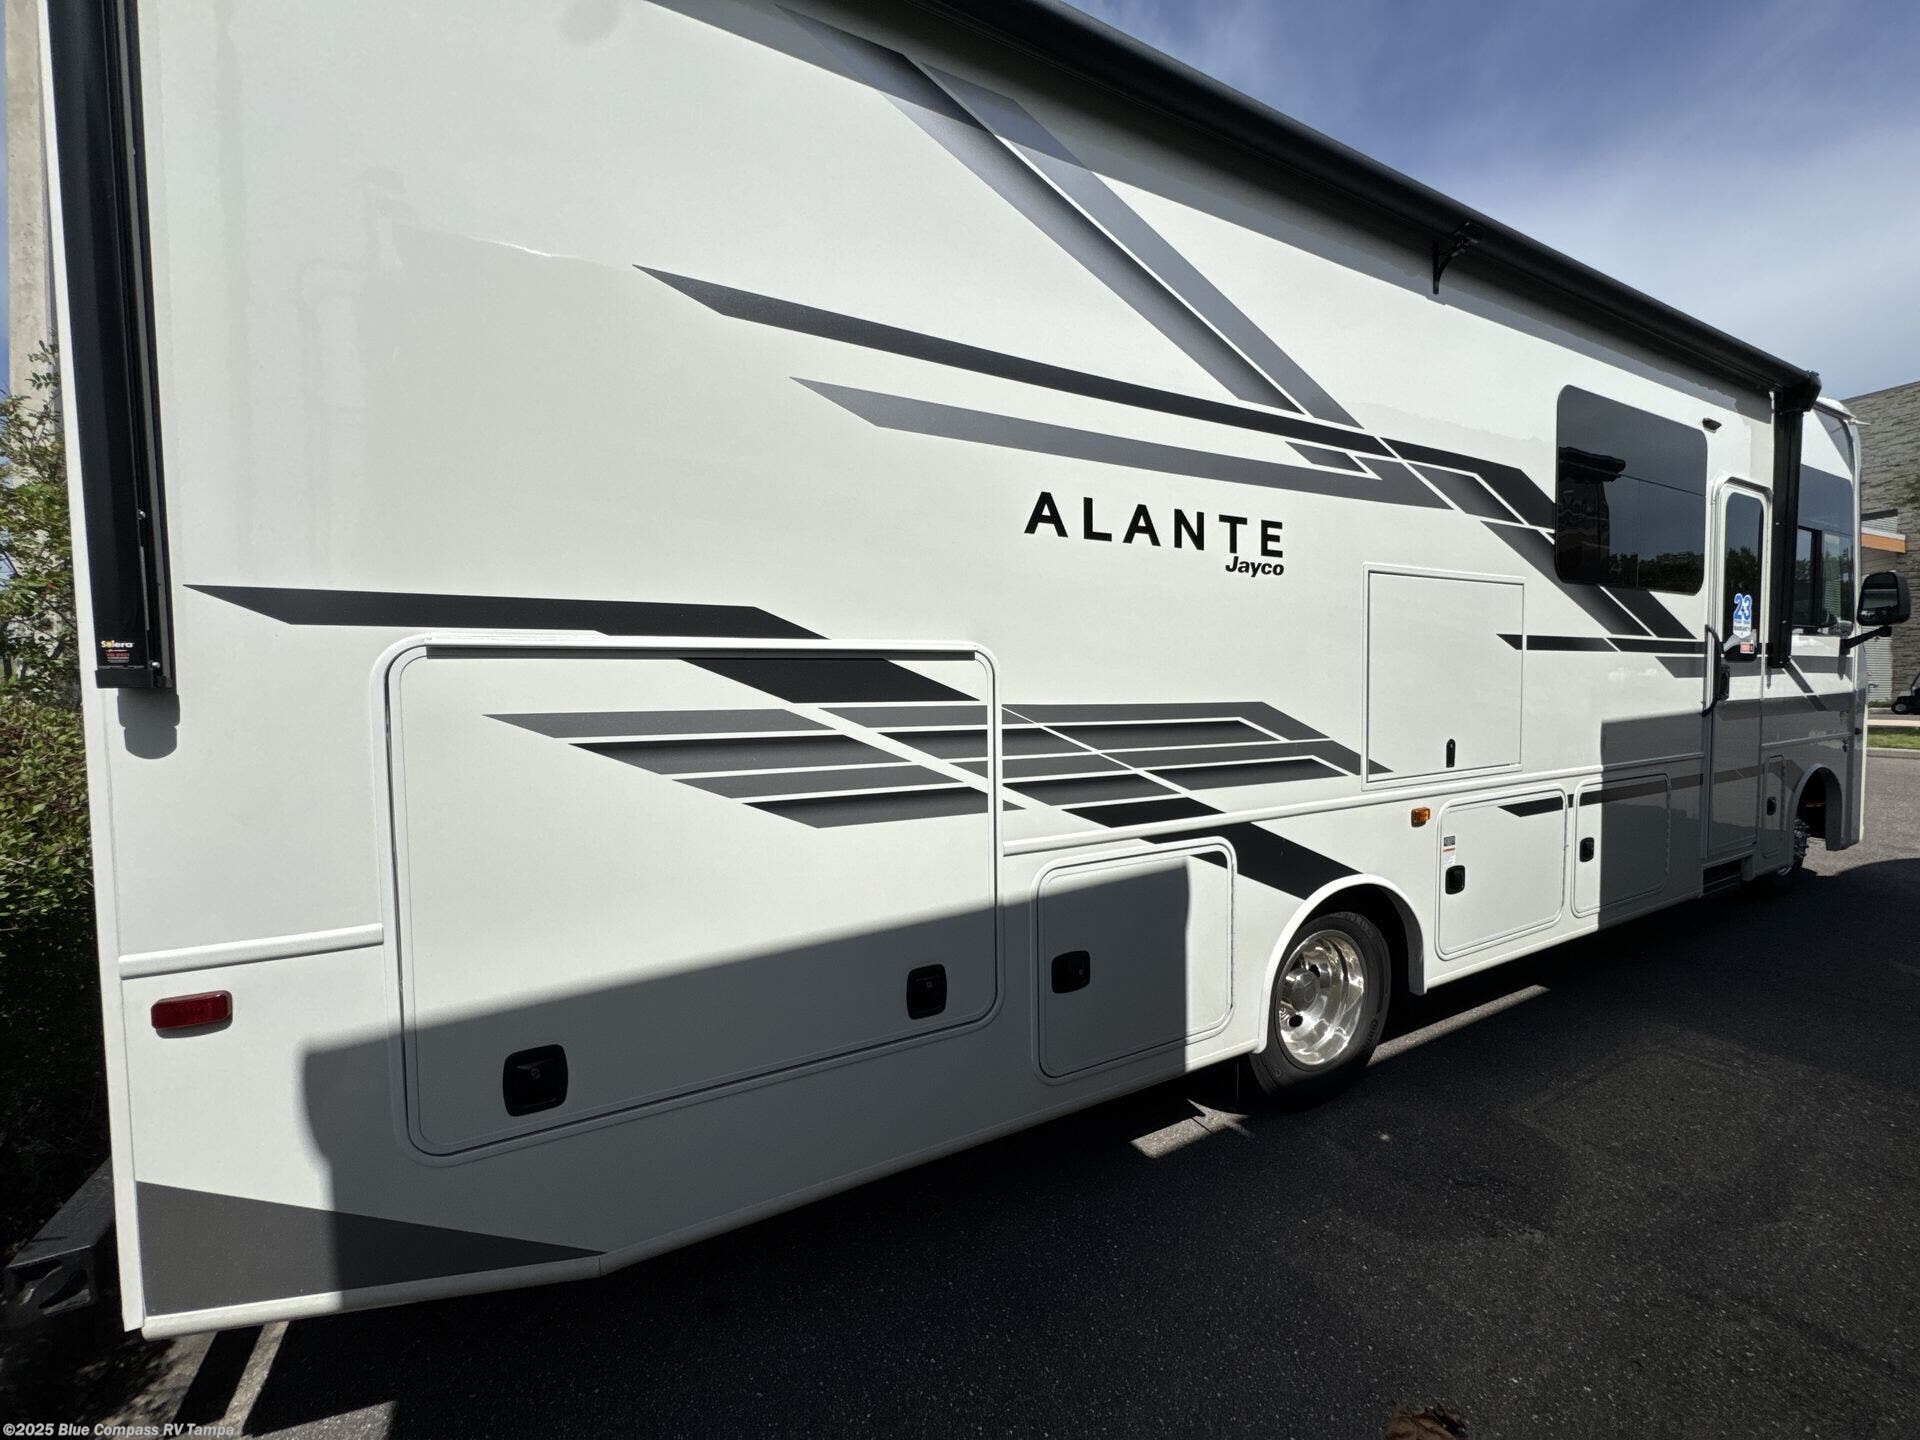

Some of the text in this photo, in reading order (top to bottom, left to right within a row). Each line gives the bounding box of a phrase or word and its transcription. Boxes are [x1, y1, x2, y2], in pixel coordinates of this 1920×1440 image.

[1023, 491, 1284, 558] ALANTE
[1225, 555, 1285, 578] Jayco
[101, 640, 133, 648] Solera
